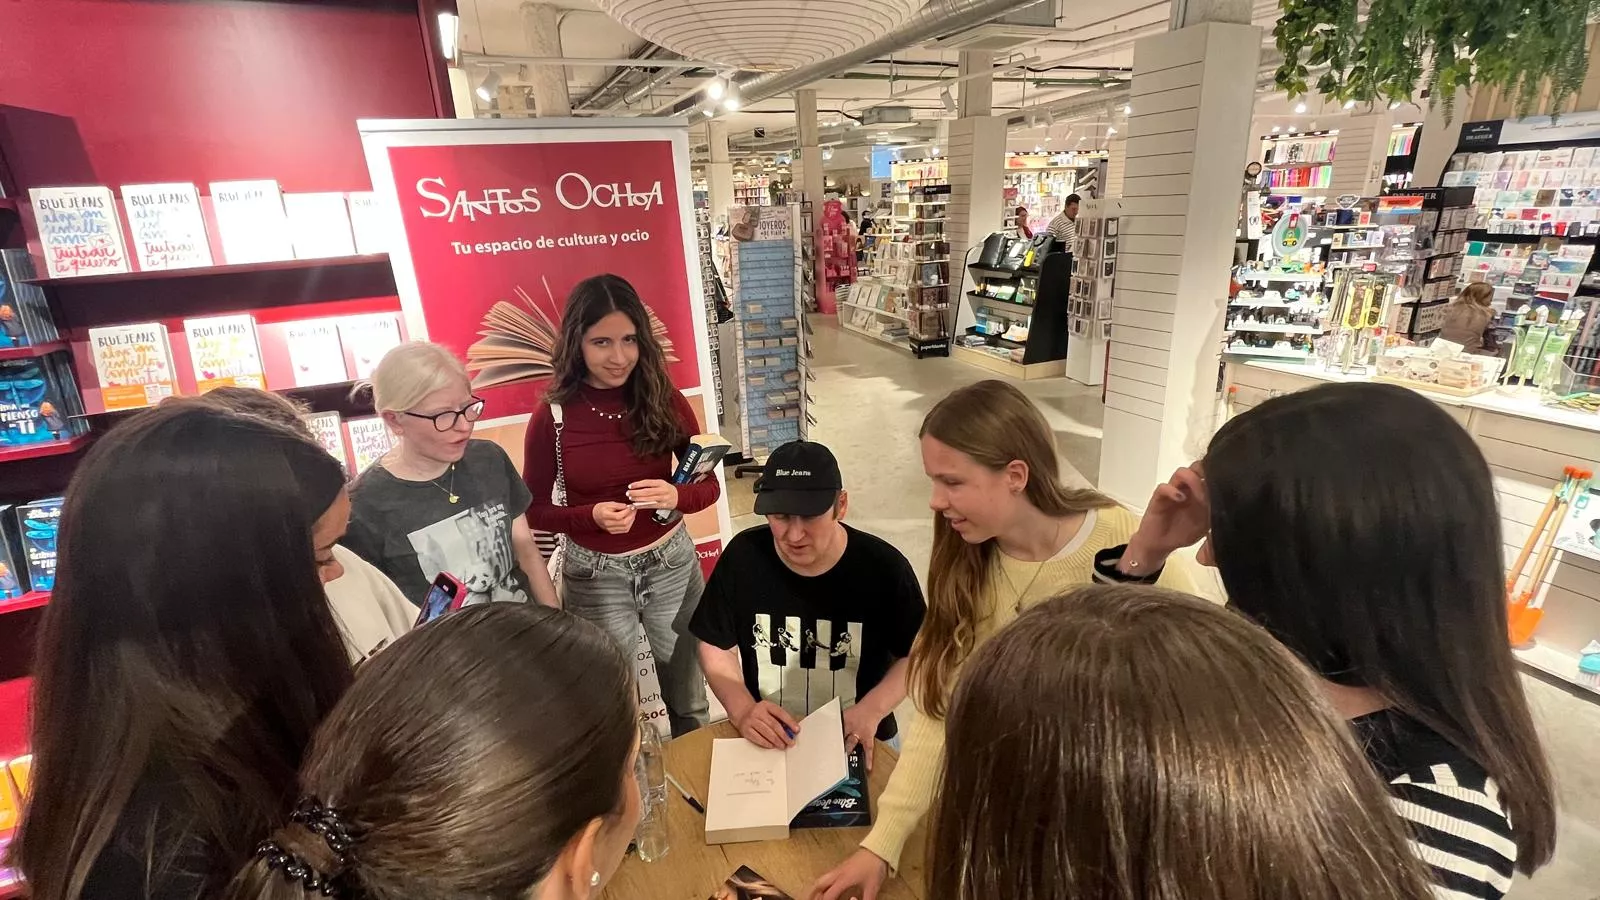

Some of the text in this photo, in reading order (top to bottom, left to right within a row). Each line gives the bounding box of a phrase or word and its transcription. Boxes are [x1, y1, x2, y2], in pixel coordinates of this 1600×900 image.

[40, 196, 104, 211] BLUE JEANS
[451, 229, 650, 255] Tu espacio de cultura y ocio
[98, 331, 156, 347] BLUE JEANS
[776, 469, 811, 477] Blue Jeans
[637, 650, 653, 661] oz
[640, 692, 660, 704] och
[644, 708, 666, 721] soc
[832, 798, 858, 809] Blue
